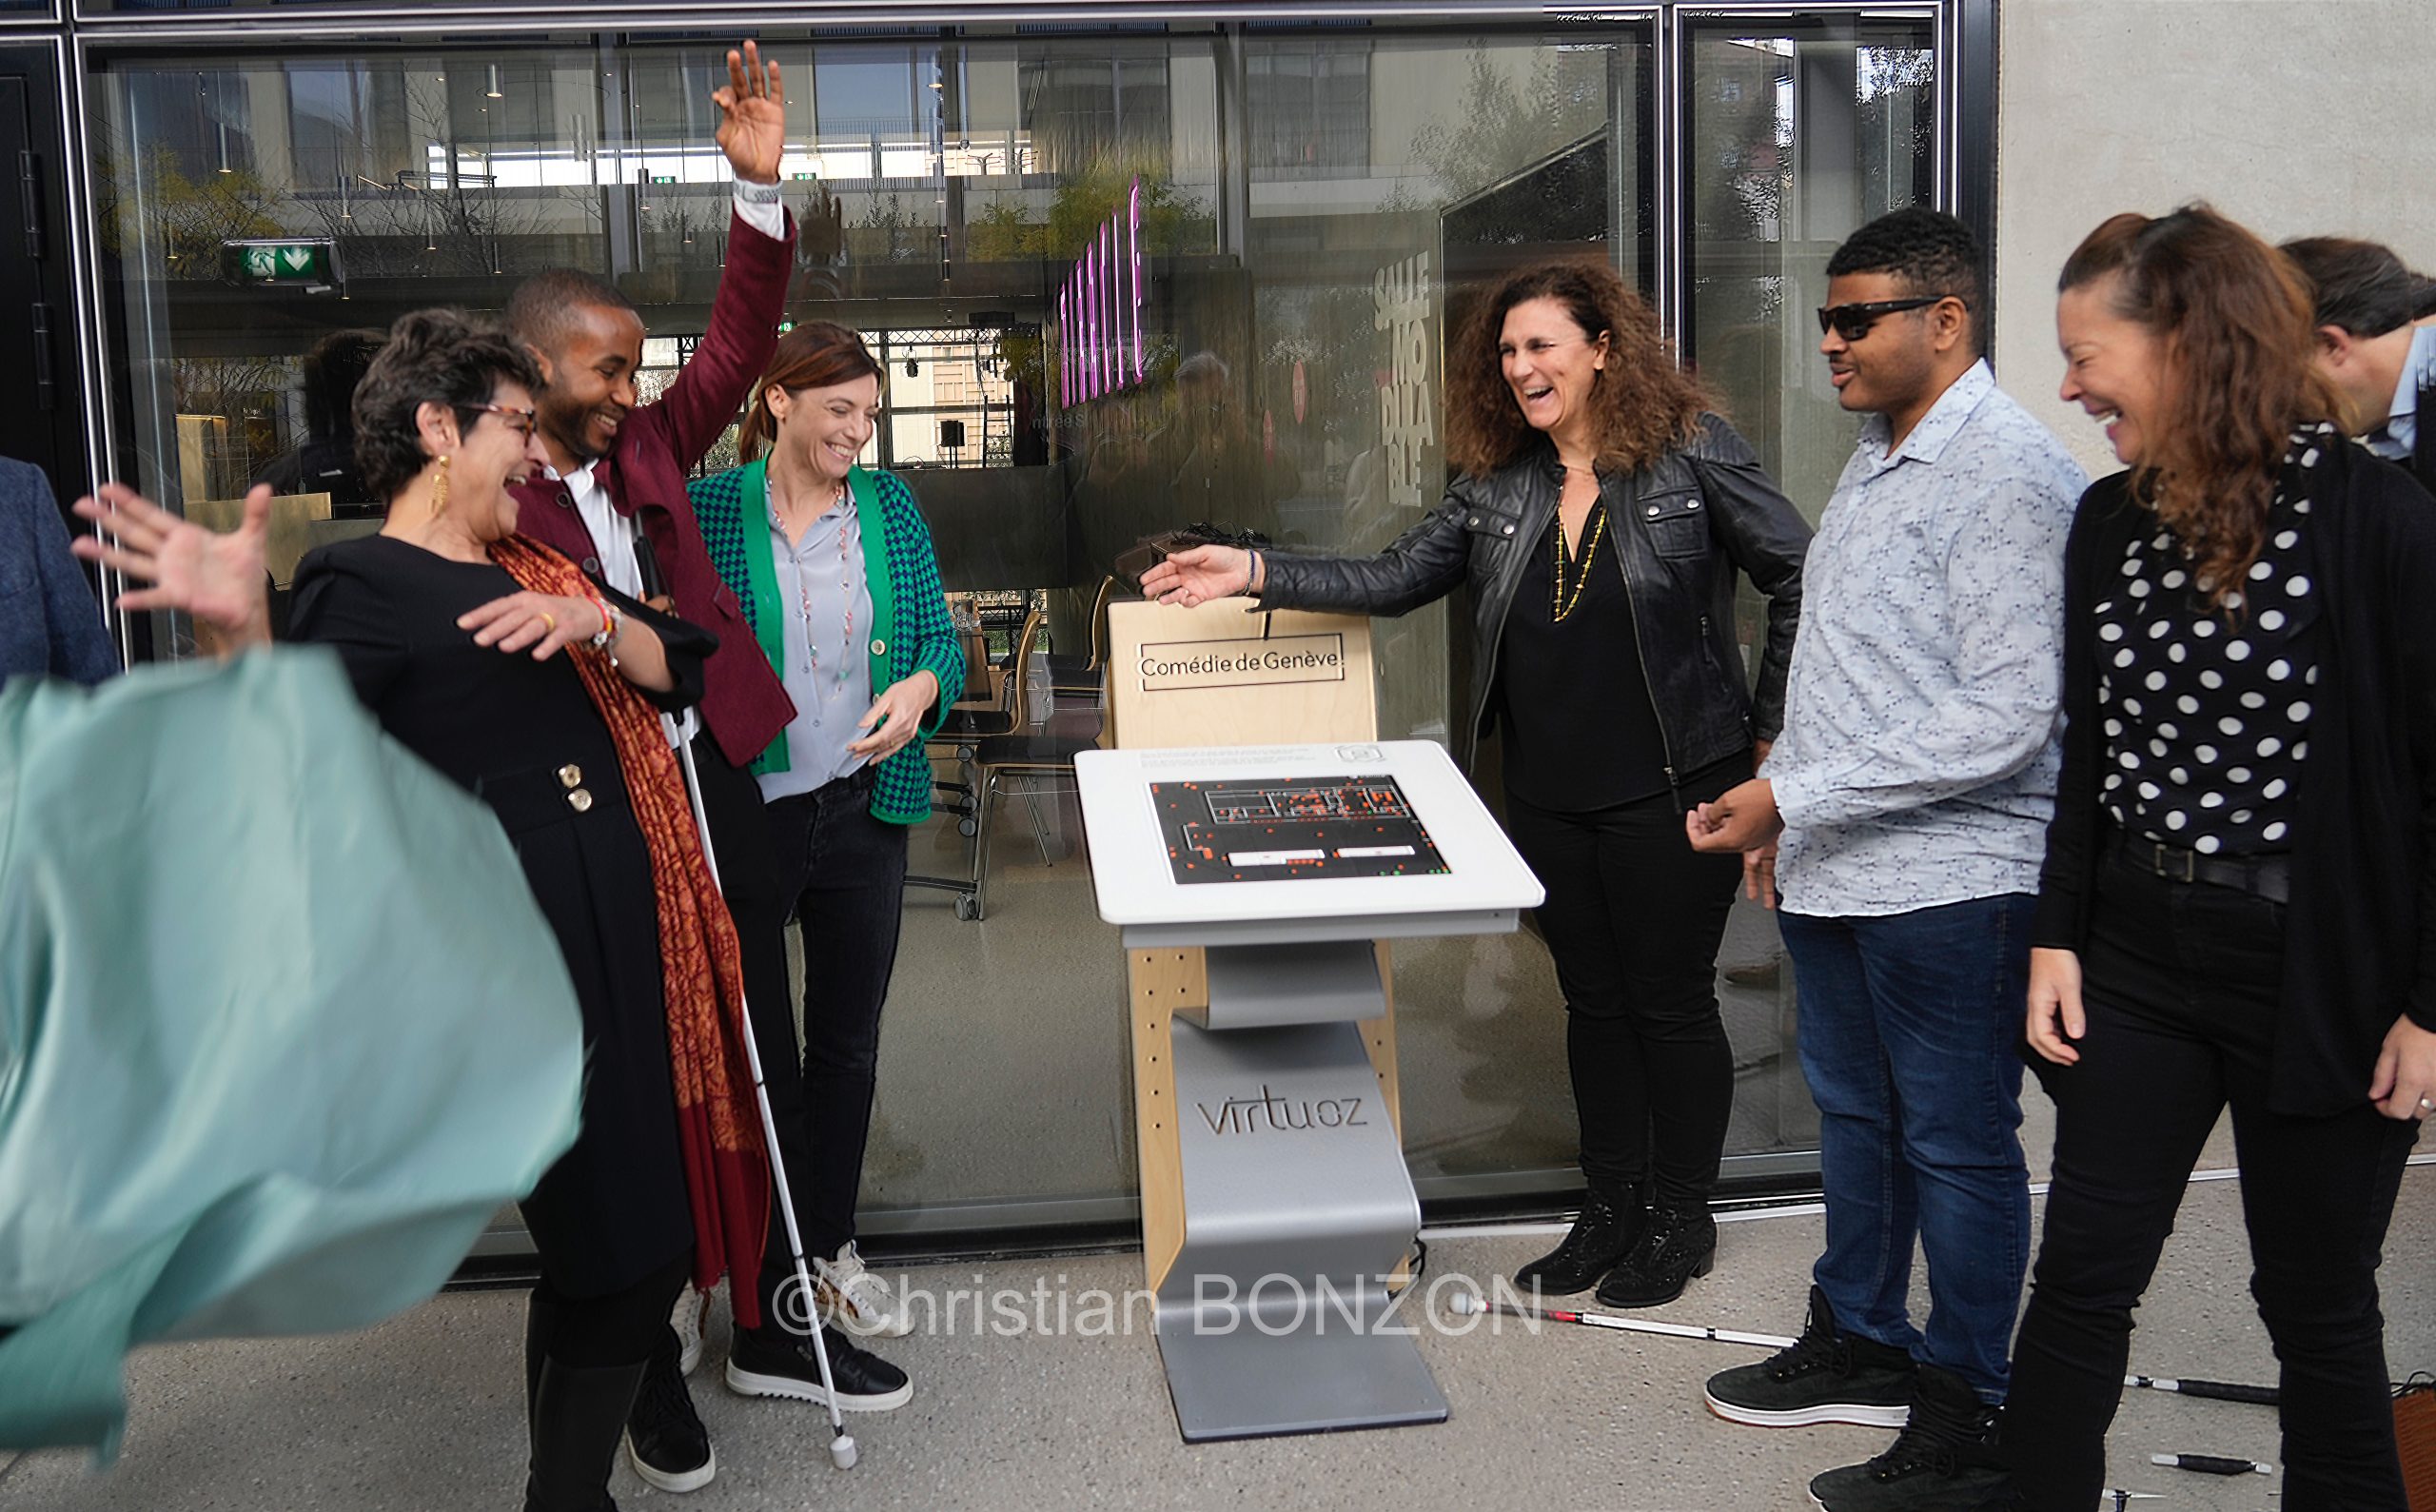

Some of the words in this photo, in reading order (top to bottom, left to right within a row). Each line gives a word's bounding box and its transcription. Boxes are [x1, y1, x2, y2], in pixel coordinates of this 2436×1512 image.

[1374, 250, 1429, 331] SALLE
[1141, 654, 1231, 677] Comédie
[1235, 653, 1260, 672] de
[1195, 1085, 1368, 1134] virtuoz
